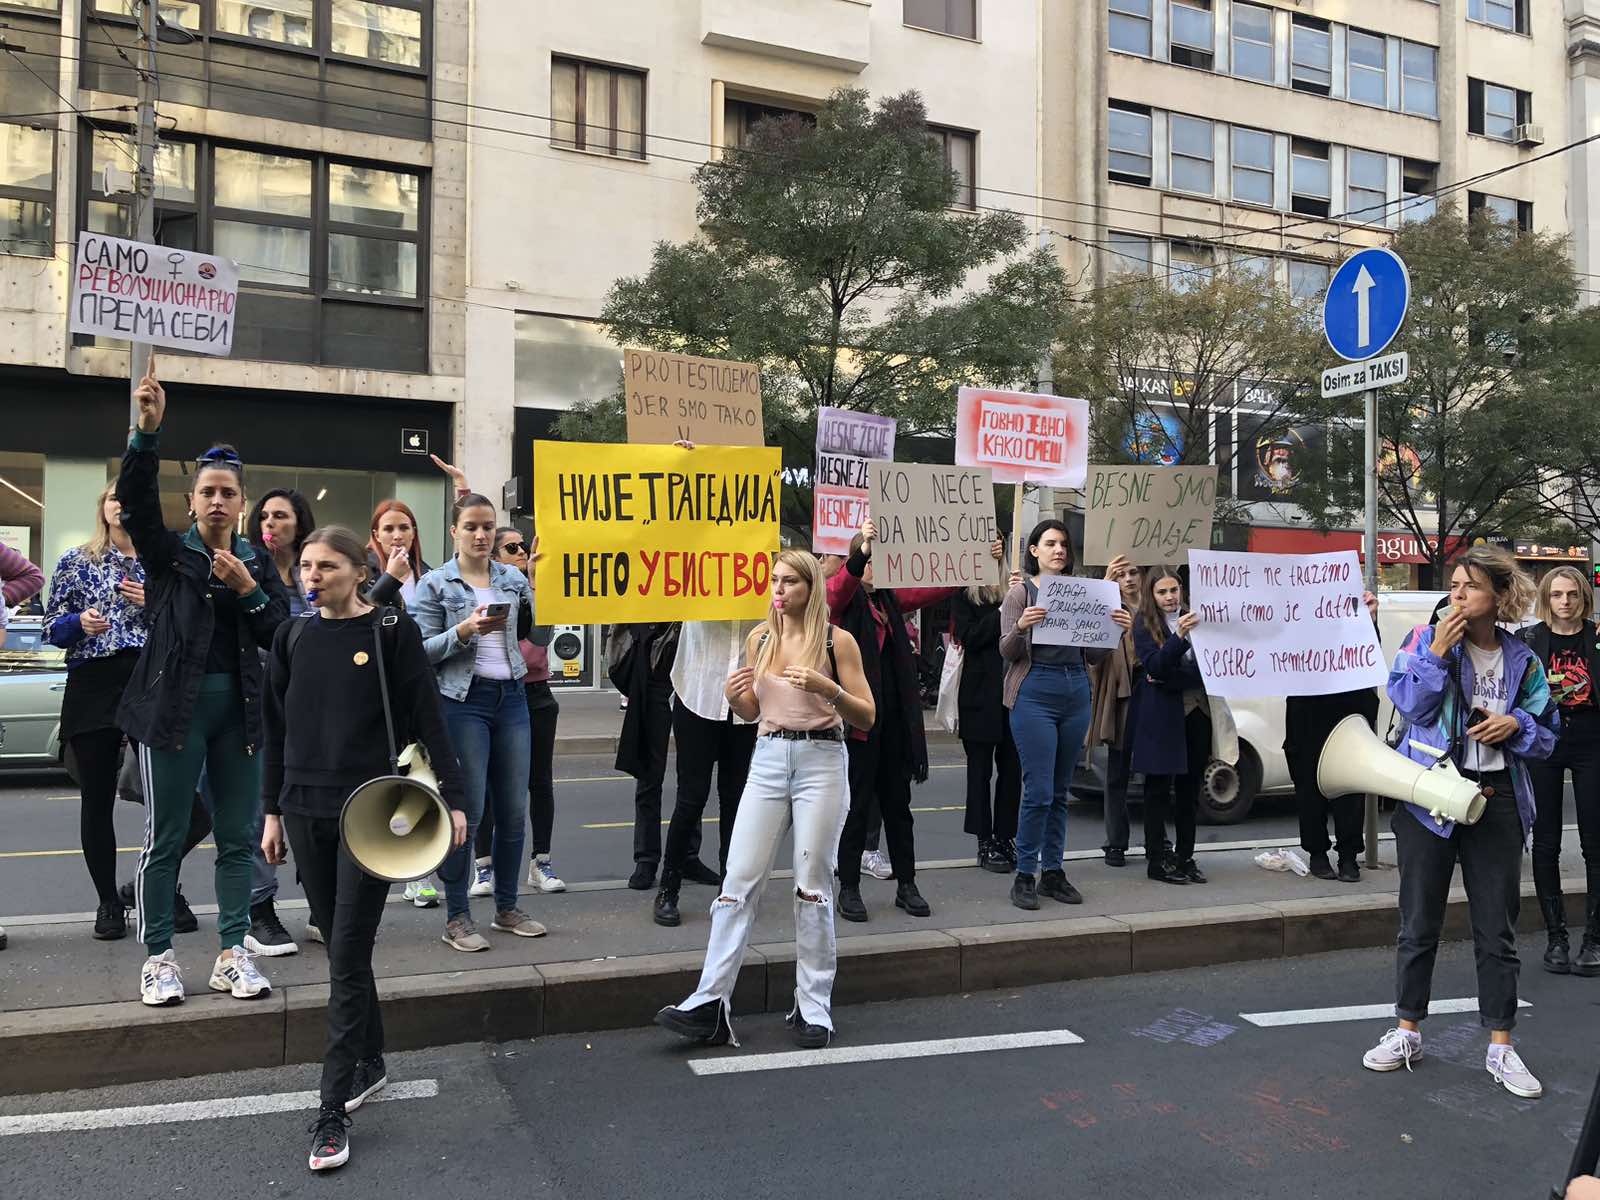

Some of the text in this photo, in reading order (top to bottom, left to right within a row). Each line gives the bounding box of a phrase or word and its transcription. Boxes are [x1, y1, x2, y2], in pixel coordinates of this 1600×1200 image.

[84, 238, 148, 274] САМО
[79, 264, 236, 315] РЕВОЛУЦИОНАРНО
[79, 292, 229, 345] ПРЕМА СЕБИ
[631, 353, 759, 395] PROTESTUJEMO
[1323, 358, 1404, 391] Osim za TAKSI
[632, 391, 757, 426] JER SMO TAKO
[981, 409, 1025, 433] ГОВНО
[983, 432, 1023, 458] КАКО
[855, 457, 869, 489] ŽE
[879, 469, 984, 505] KO NEĆE
[558, 472, 635, 522] НИЈЕ
[1091, 471, 1156, 510] BESNE
[1166, 472, 1215, 508] SMO
[879, 512, 997, 544] DA NAS ČUJE
[1106, 517, 1115, 549] I
[563, 551, 630, 598] НЕГО
[887, 550, 983, 583] MORAĆE
[1197, 561, 1252, 588] milost
[1263, 566, 1282, 587] ne
[1046, 580, 1087, 600] DRAGA
[1071, 619, 1101, 631] SAMO
[1199, 601, 1230, 623] niti
[1283, 600, 1302, 623] je
